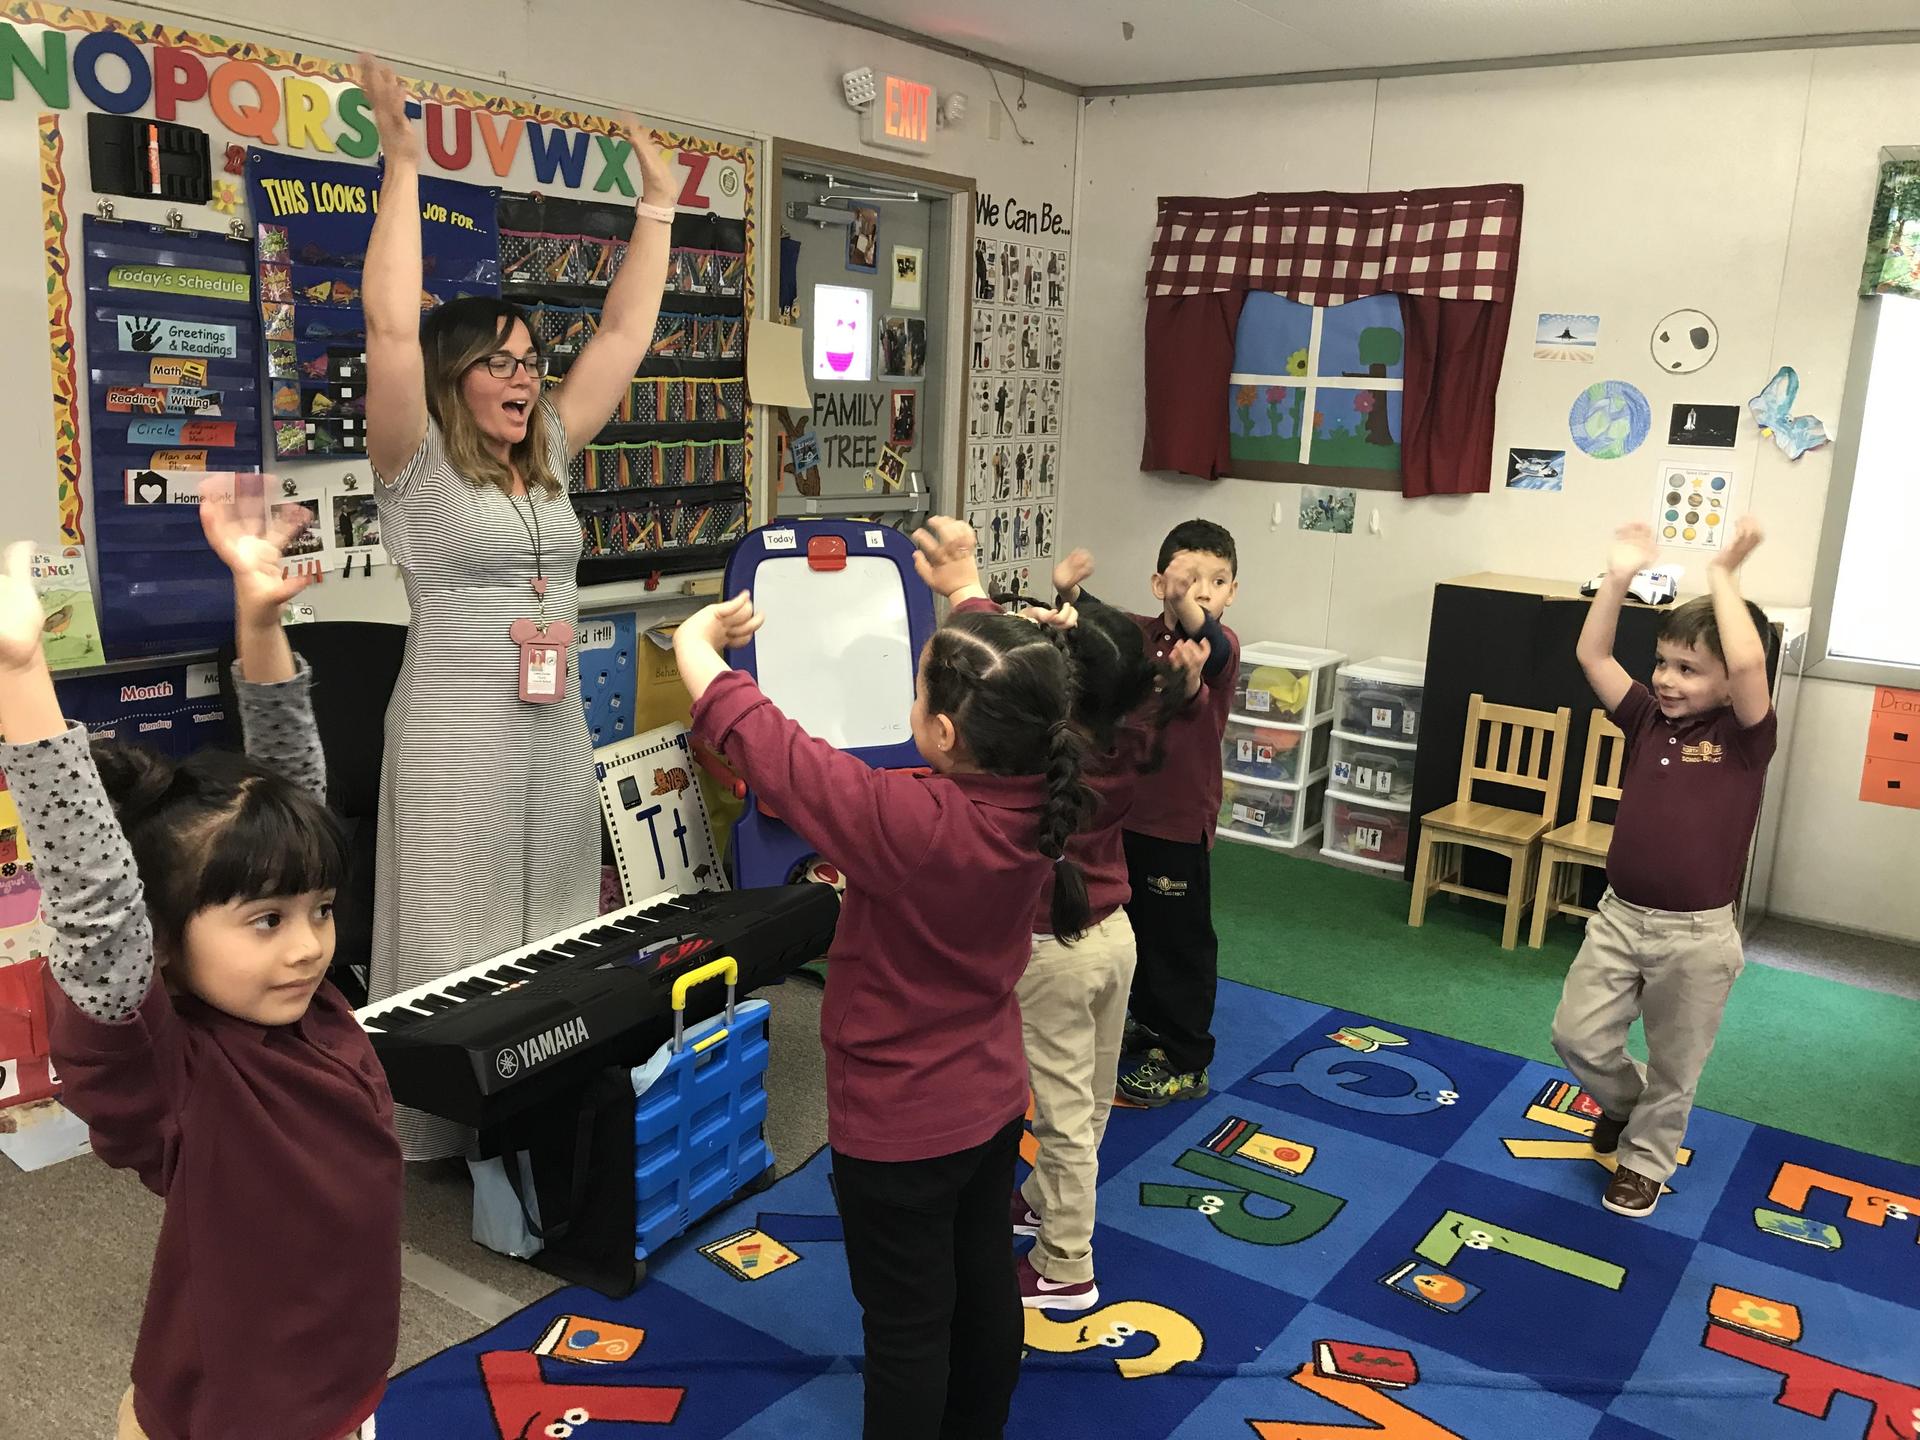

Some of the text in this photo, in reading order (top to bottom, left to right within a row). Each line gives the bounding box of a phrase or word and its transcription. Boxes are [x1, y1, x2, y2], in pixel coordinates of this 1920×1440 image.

[884, 75, 931, 143] EXIT
[261, 179, 308, 216] THIS
[311, 182, 366, 213] LOOKS
[423, 203, 447, 222] JOB
[975, 192, 1071, 235] We Can Be...
[117, 268, 171, 286] Today's
[179, 275, 244, 295] Schedule
[168, 326, 225, 342] Greetings
[169, 341, 232, 356] & Readings
[152, 364, 182, 377] Math
[109, 393, 157, 407] Reading
[170, 395, 210, 409] Writing
[812, 392, 885, 427] FAMILY
[137, 424, 175, 436] Circle
[160, 452, 202, 460] Plan and
[823, 434, 877, 469] TREE
[174, 492, 206, 503] Home
[767, 535, 878, 545] Today is
[300, 607, 312, 615] 8
[593, 626, 612, 642] it!!!
[121, 682, 173, 702] Month
[87, 711, 224, 740] unday Monday Tuesday
[517, 1016, 589, 1068] YAMAHA
